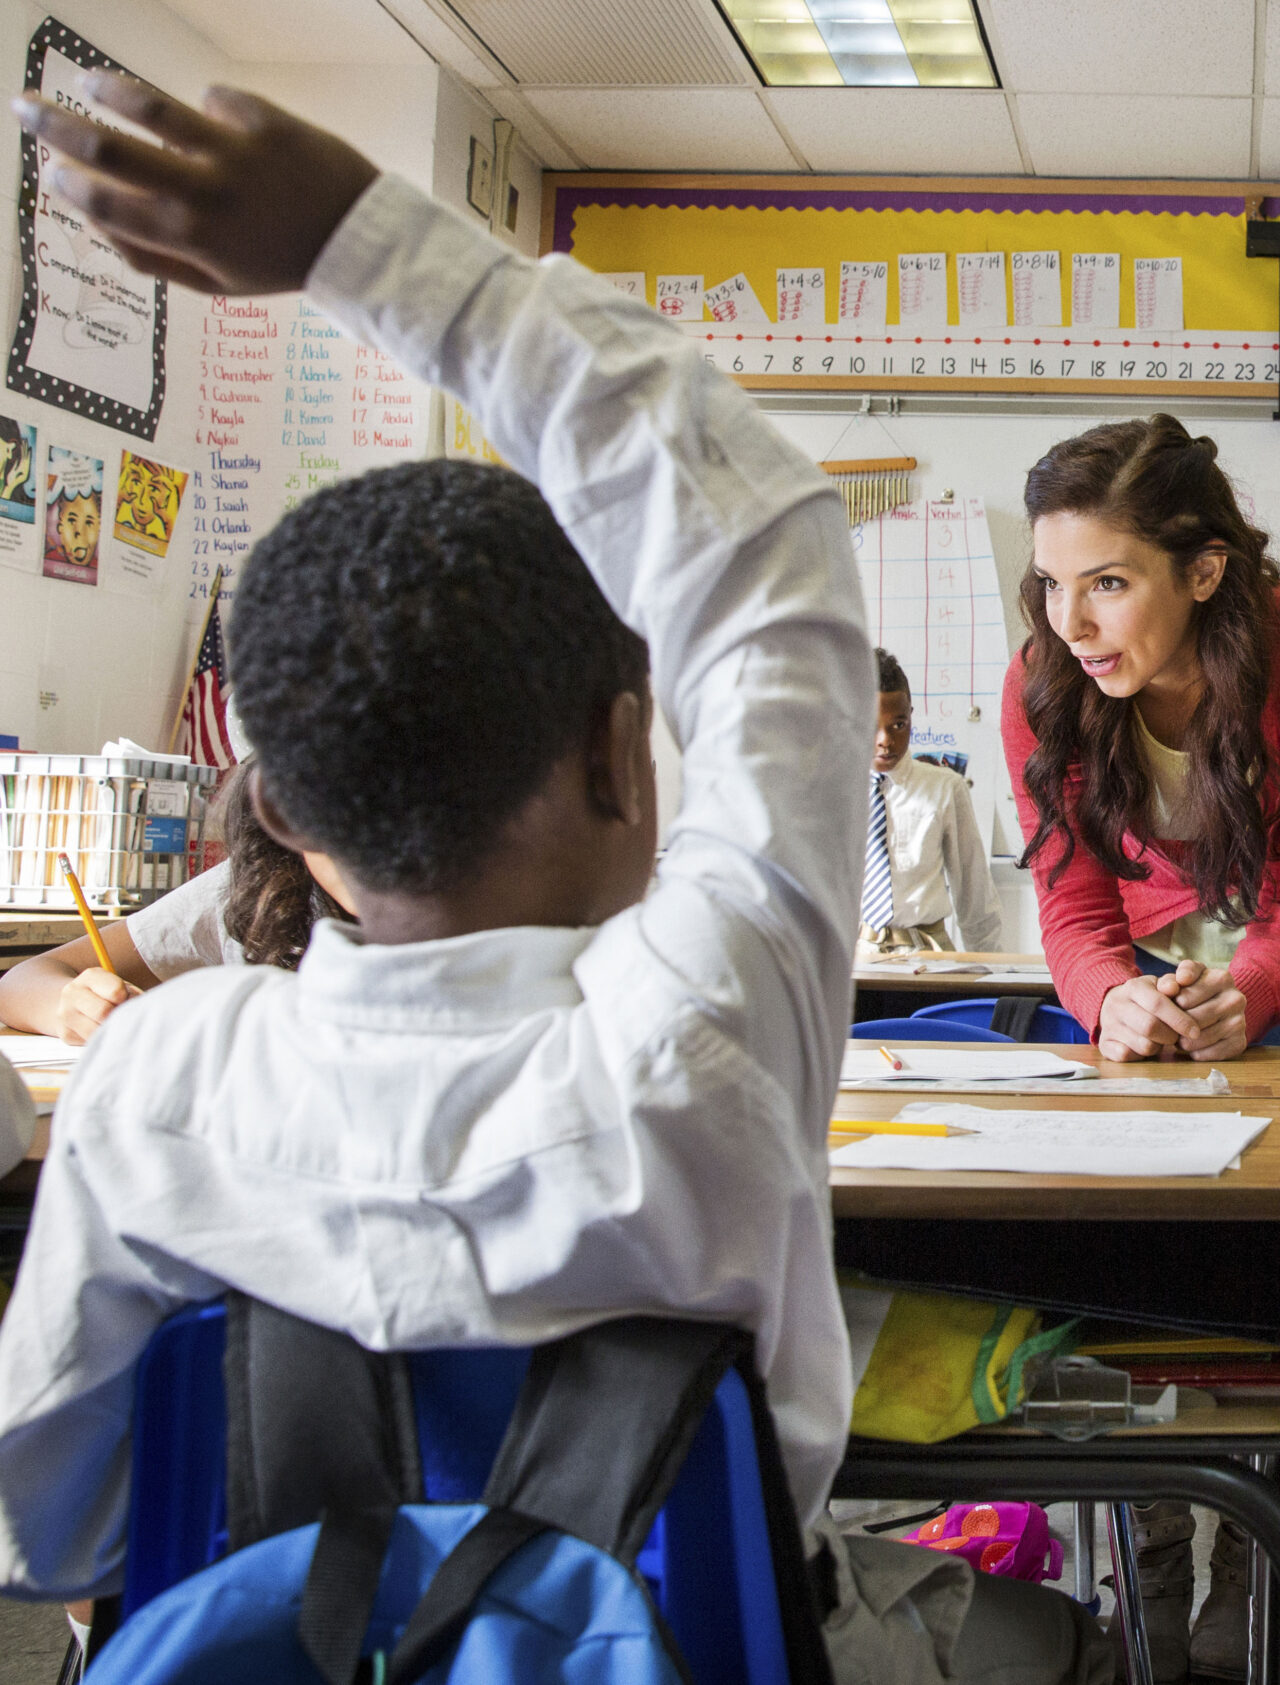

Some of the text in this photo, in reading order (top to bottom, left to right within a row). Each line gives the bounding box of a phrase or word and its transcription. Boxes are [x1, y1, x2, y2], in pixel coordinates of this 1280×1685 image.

[211, 295, 269, 322] Monday
[217, 342, 269, 360] Ezekiel
[733, 355, 744, 371] 6
[764, 354, 774, 371] 7
[792, 355, 804, 372] 8
[821, 356, 834, 372] 9
[849, 356, 866, 373] 10
[883, 357, 893, 373] 11
[911, 357, 925, 374] 12
[941, 357, 956, 374] 13
[970, 357, 987, 374] 14
[1000, 357, 1017, 374] 15
[1030, 358, 1045, 375] 16
[1061, 359, 1075, 376] 17
[1091, 360, 1106, 378] 18
[1120, 360, 1137, 377] 19
[1146, 360, 1168, 378] 20
[1178, 361, 1193, 378] 21
[1204, 362, 1225, 379] 22
[1234, 362, 1255, 380] 23
[211, 407, 245, 429] Kayla
[297, 430, 326, 446] David
[373, 430, 413, 448] Mariah
[210, 450, 261, 473] Thursday
[299, 450, 339, 471] Friday
[215, 496, 248, 512] Isaiah
[890, 508, 919, 520] Angles
[211, 517, 252, 534] Orlando
